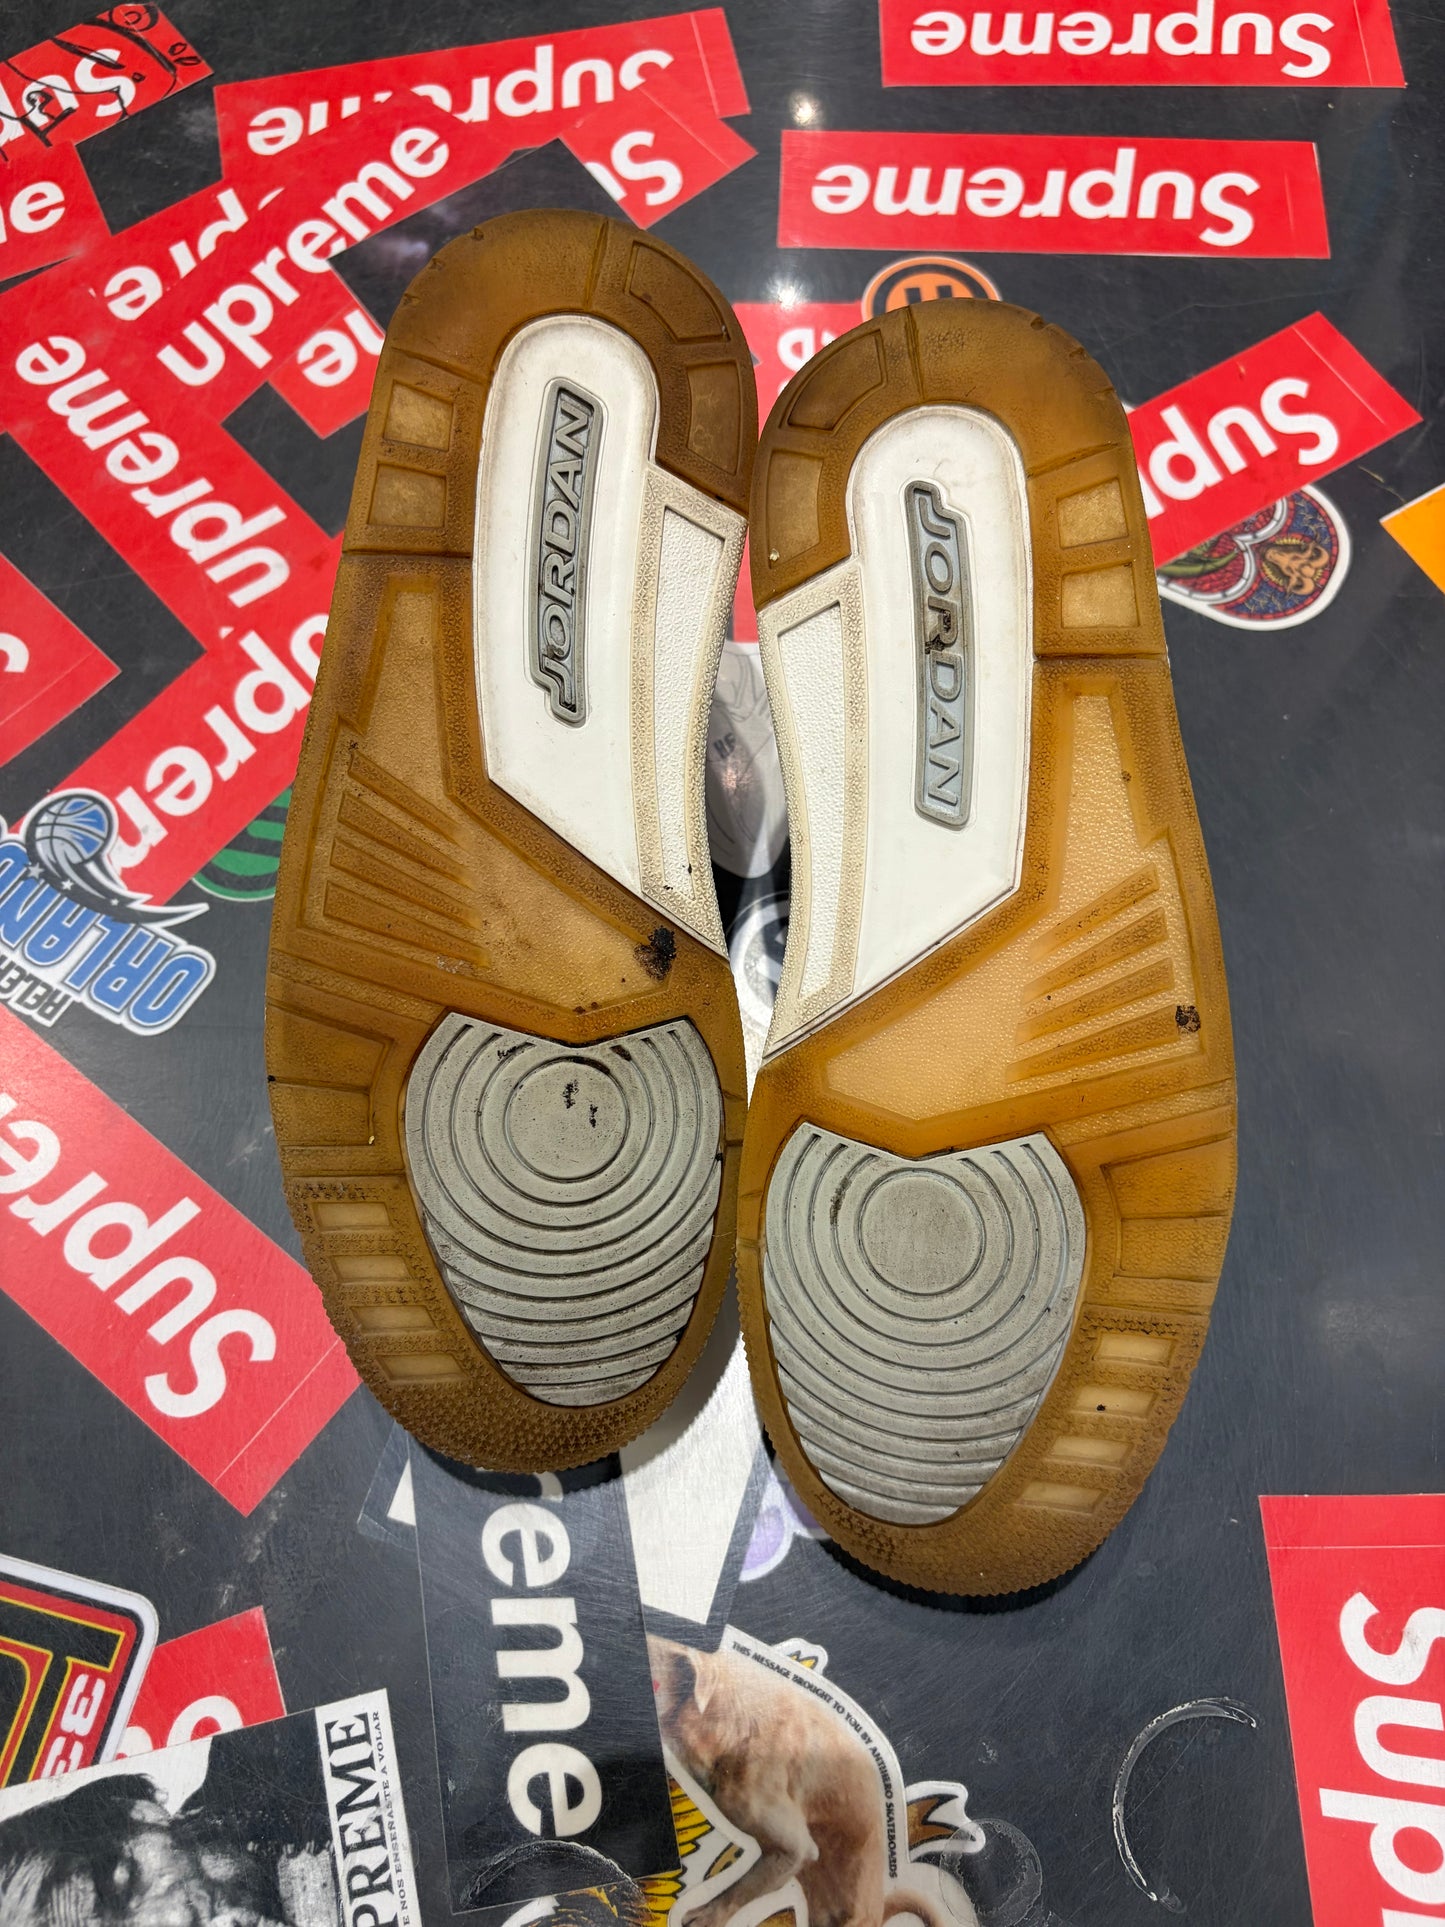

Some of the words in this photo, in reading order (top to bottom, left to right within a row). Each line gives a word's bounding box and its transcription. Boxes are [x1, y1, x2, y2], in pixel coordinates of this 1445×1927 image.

[911, 0, 1334, 78] Supreme
[811, 147, 1260, 247] Supreme
[16, 335, 290, 620] upreme
[542, 400, 591, 708] JORDAN
[917, 496, 962, 807] JORDAN
[0, 1092, 277, 1419] Supre
[372, 1710, 386, 1764] VOLAR
[732, 1640, 751, 1657] THIS
[751, 1652, 791, 1680] MESSAGE
[792, 1673, 833, 1704] BROUGHT
[832, 1700, 845, 1715] TO
[844, 1713, 862, 1733] YOU
[861, 1728, 873, 1745] BY
[870, 1746, 893, 1800] ANTIHERO
[885, 1802, 898, 1879] SKATEBOARDS
[1319, 1591, 1445, 1927] Sup
[397, 1879, 409, 1911] NOS
